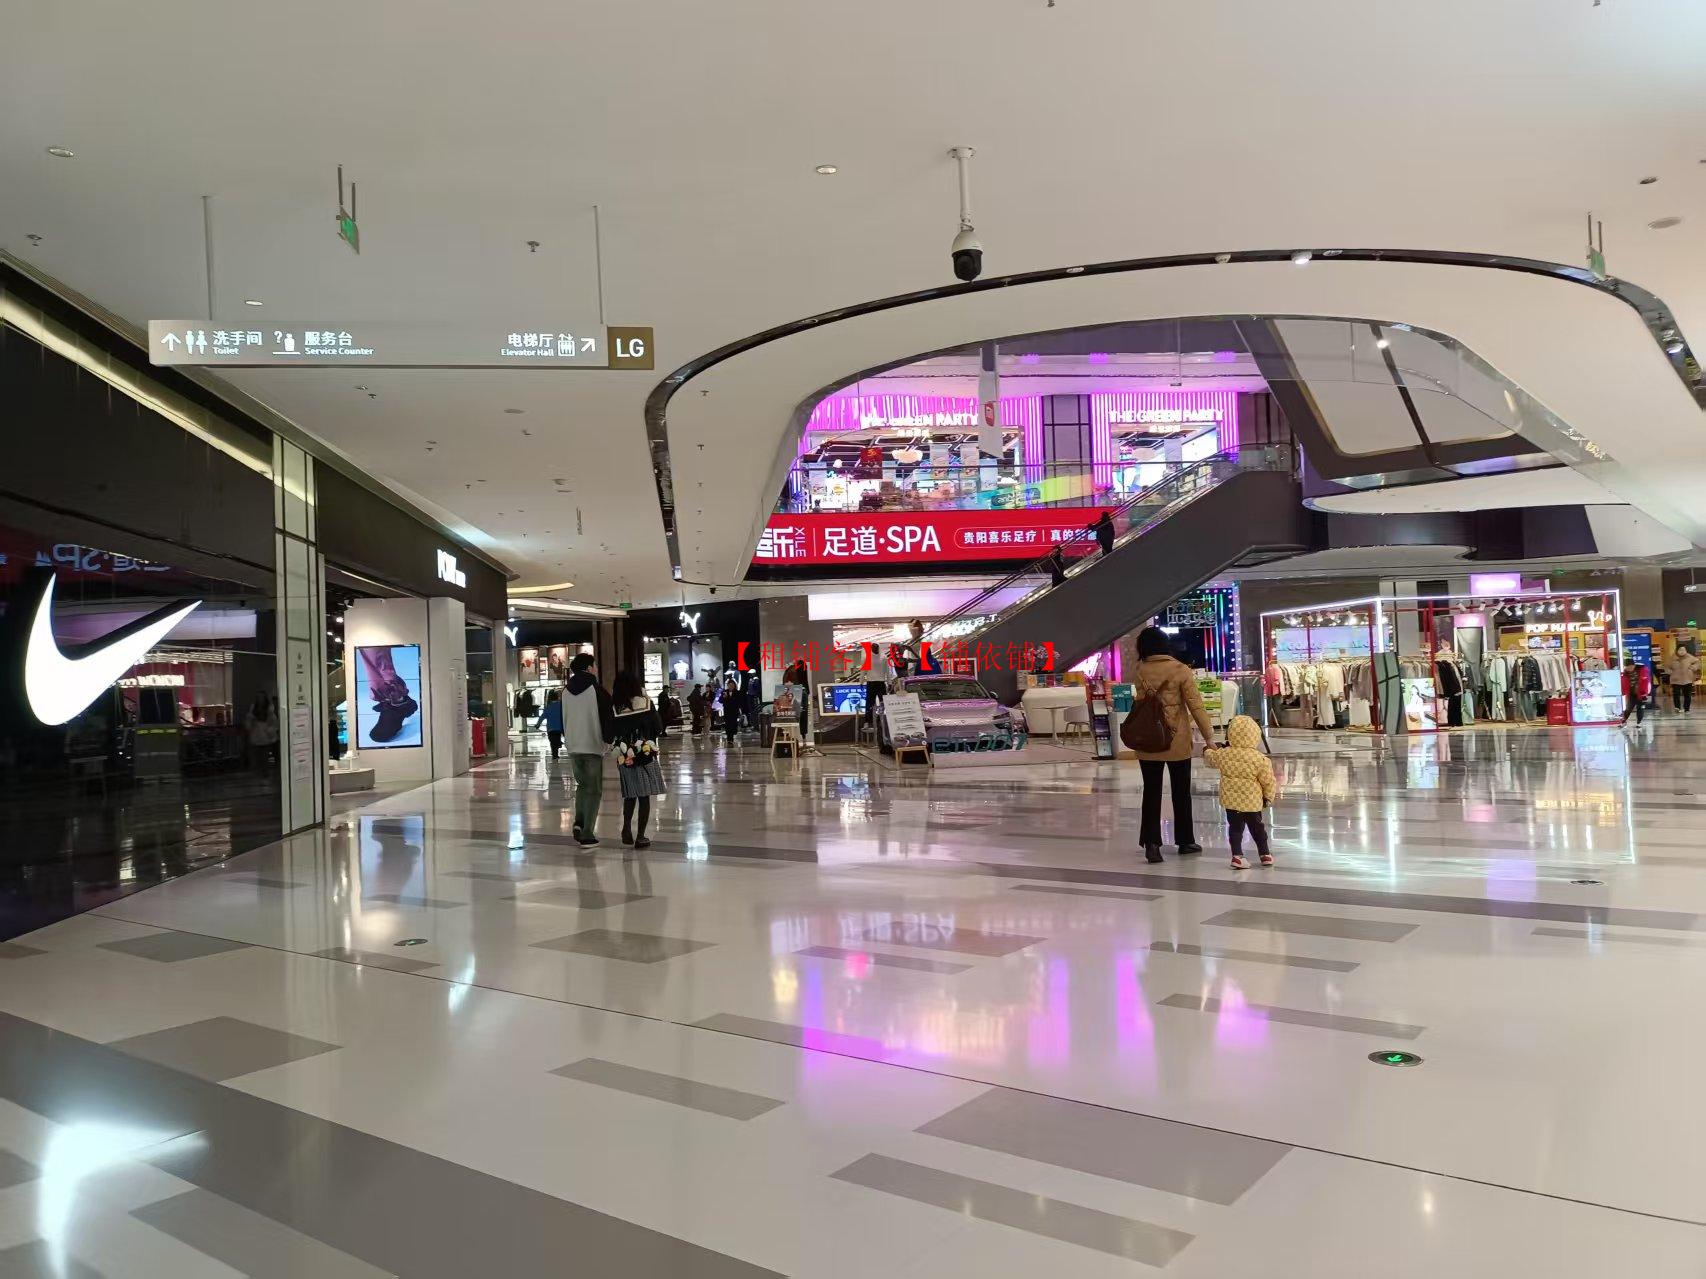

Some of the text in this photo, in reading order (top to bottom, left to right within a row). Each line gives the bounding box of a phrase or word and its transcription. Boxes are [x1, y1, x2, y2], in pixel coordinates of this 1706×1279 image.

[213, 330, 263, 346] 洗手间
[304, 331, 353, 346] 服务台
[508, 332, 553, 347] 电梯厅
[212, 346, 240, 355] Toilet
[304, 347, 375, 356] Service Counter
[501, 348, 555, 357] Elevator Hall
[616, 338, 645, 357] LG
[1137, 409, 1182, 422] GREEN
[1183, 408, 1224, 421] PARTY
[963, 530, 1037, 544] 贵阳喜乐足疗
